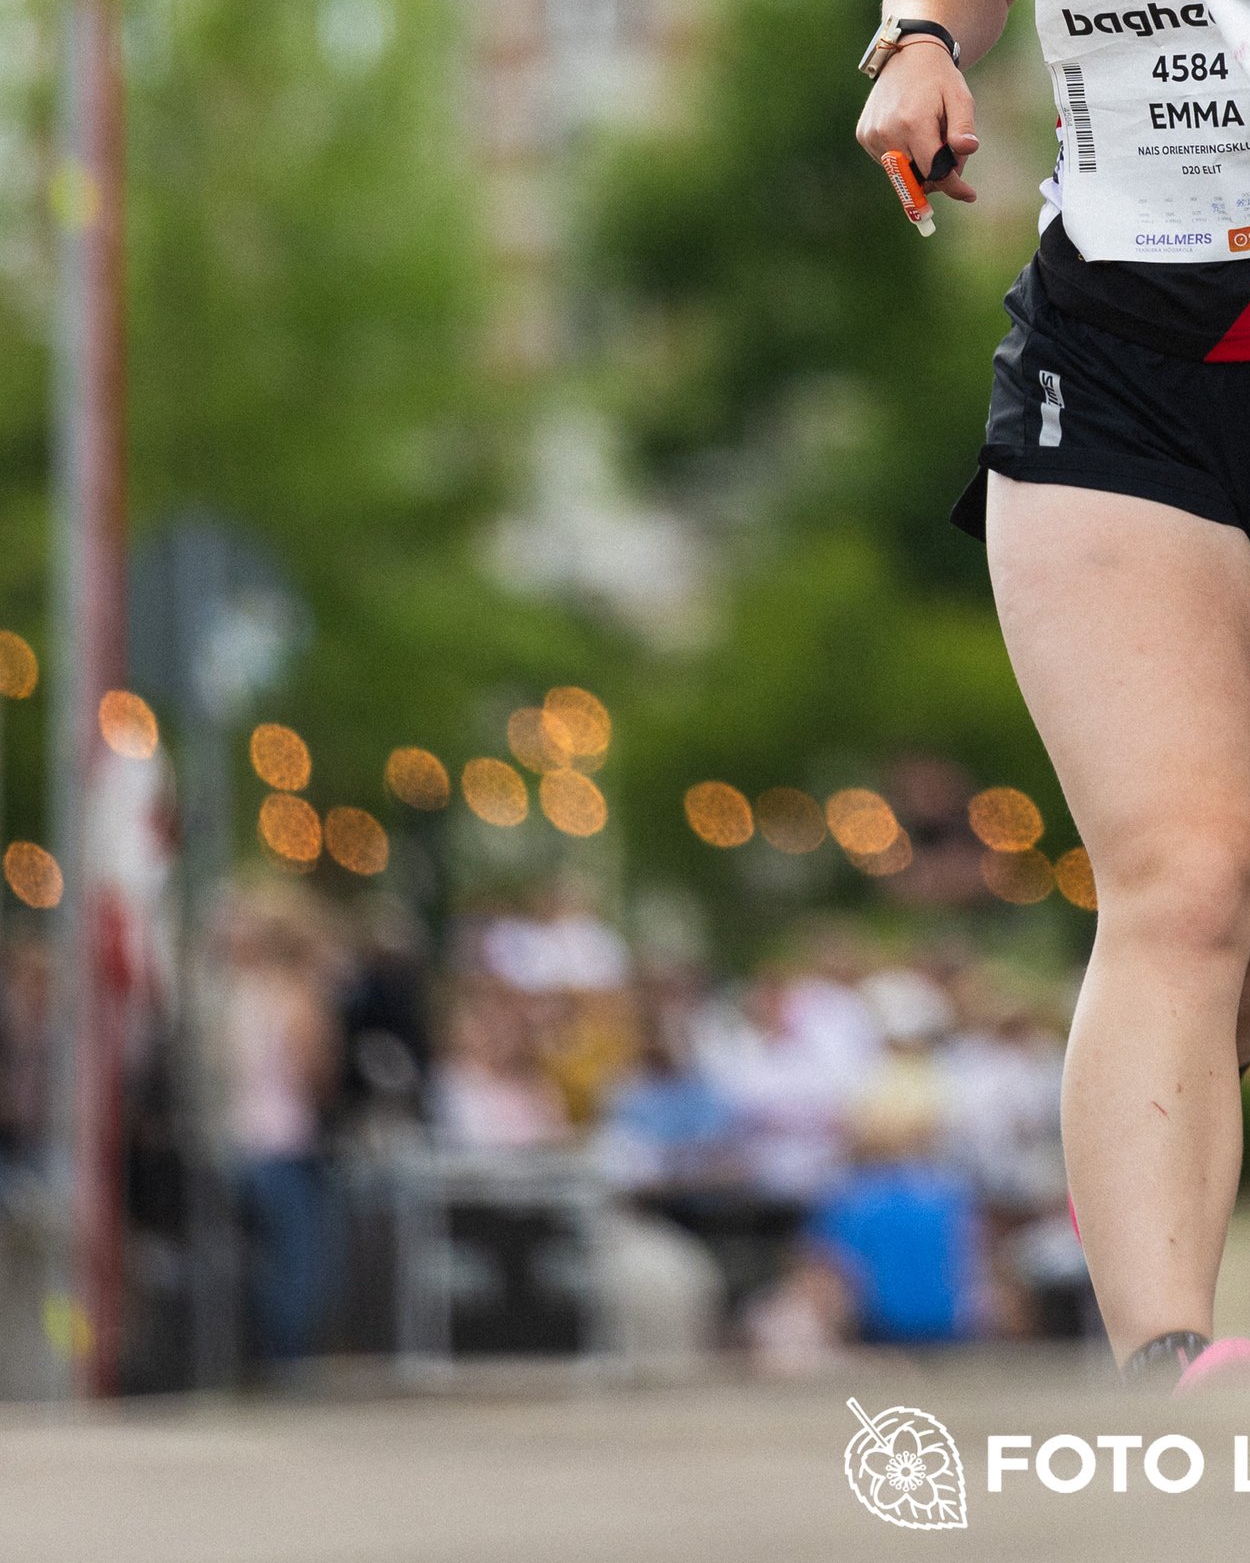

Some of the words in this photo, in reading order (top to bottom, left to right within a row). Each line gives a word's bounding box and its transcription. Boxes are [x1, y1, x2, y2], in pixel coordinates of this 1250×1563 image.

[1061, 2, 1216, 37] baghe
[1152, 52, 1229, 82] 4584
[1148, 99, 1246, 129] EMMA
[1137, 145, 1160, 156] NAIS
[1181, 165, 1201, 175] D20
[1202, 164, 1222, 175] ELIT
[1135, 233, 1213, 246] CHALMERS
[1041, 372, 1063, 407] Swi
